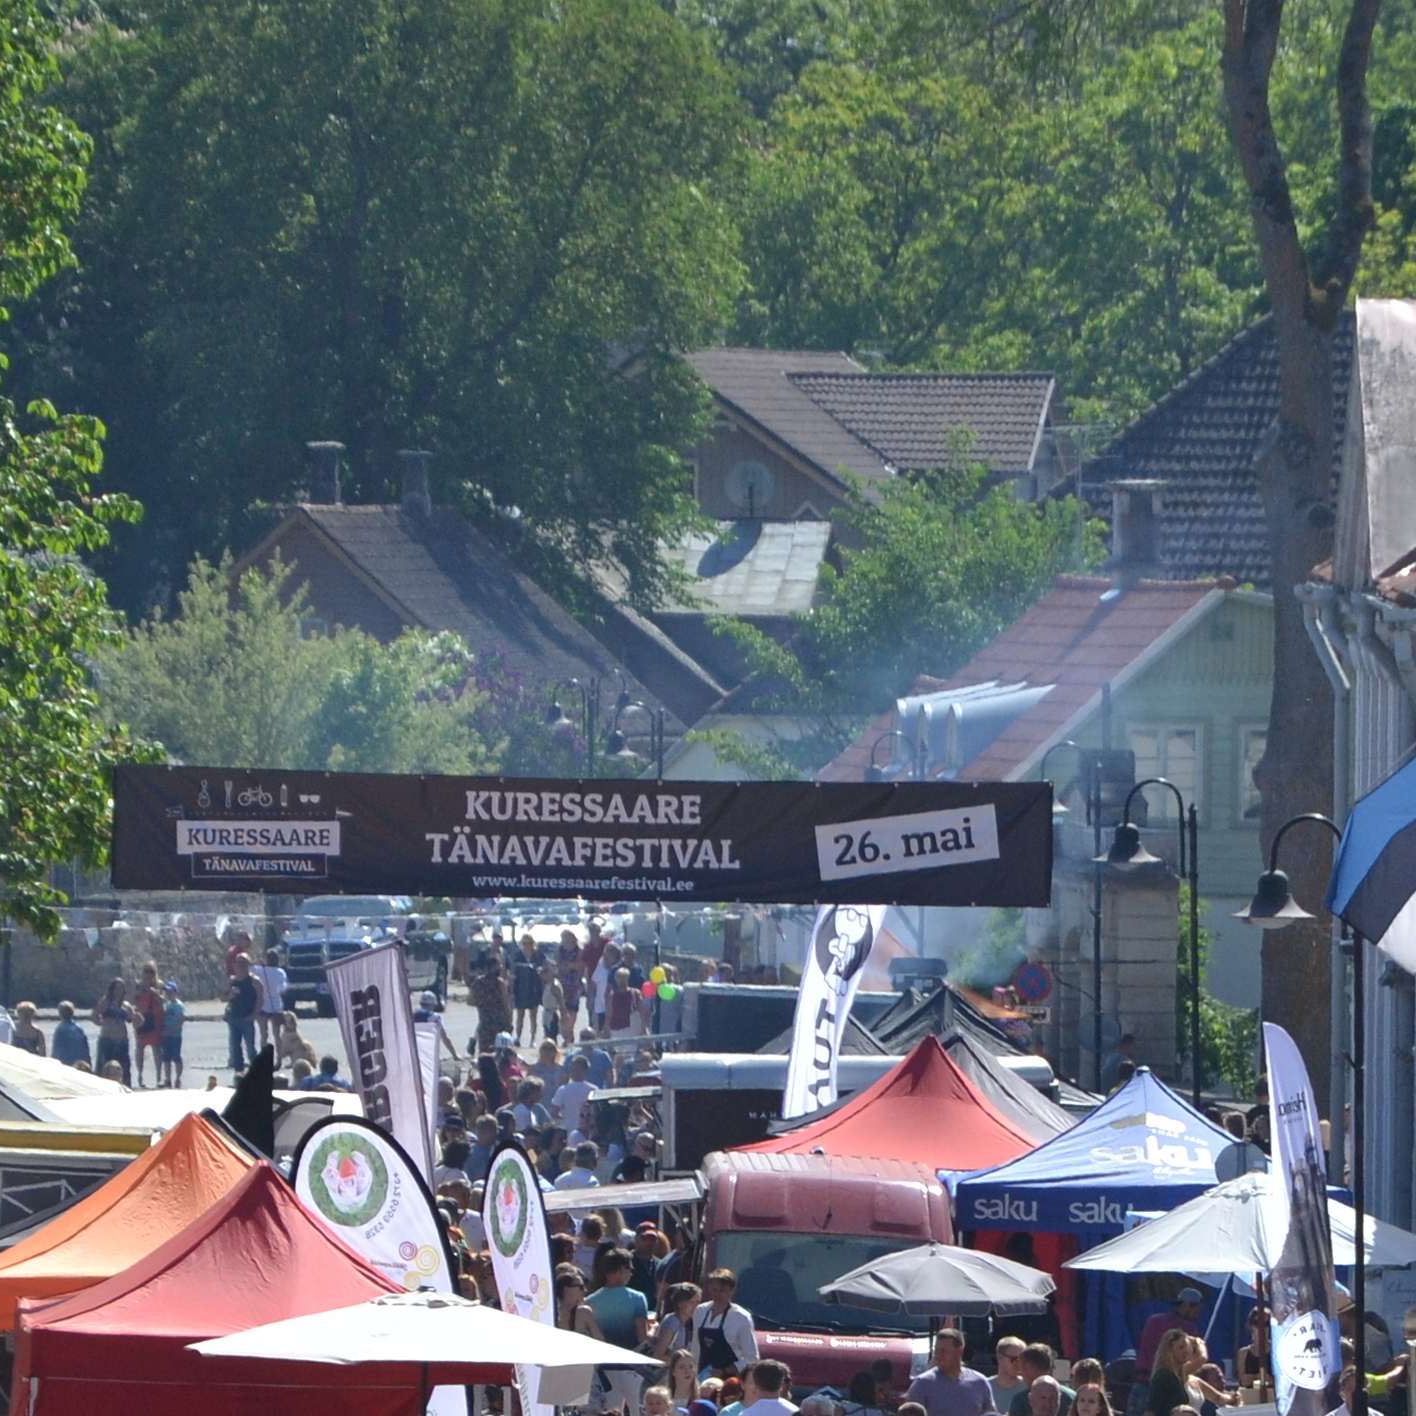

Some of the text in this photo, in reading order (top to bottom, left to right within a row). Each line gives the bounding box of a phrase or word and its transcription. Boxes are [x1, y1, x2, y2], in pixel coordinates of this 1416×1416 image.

[465, 790, 702, 825] KURESSAARE
[186, 828, 331, 847] KURESSAARE
[425, 825, 741, 870] TÄNAVAFESTIVAL
[833, 817, 976, 866] 26. mai
[203, 857, 315, 873] TÄNAVAFESTIVAL
[472, 874, 694, 892] www.kuressaarefestival.ee
[973, 1193, 1038, 1222] saku
[1068, 1196, 1133, 1223] saku
